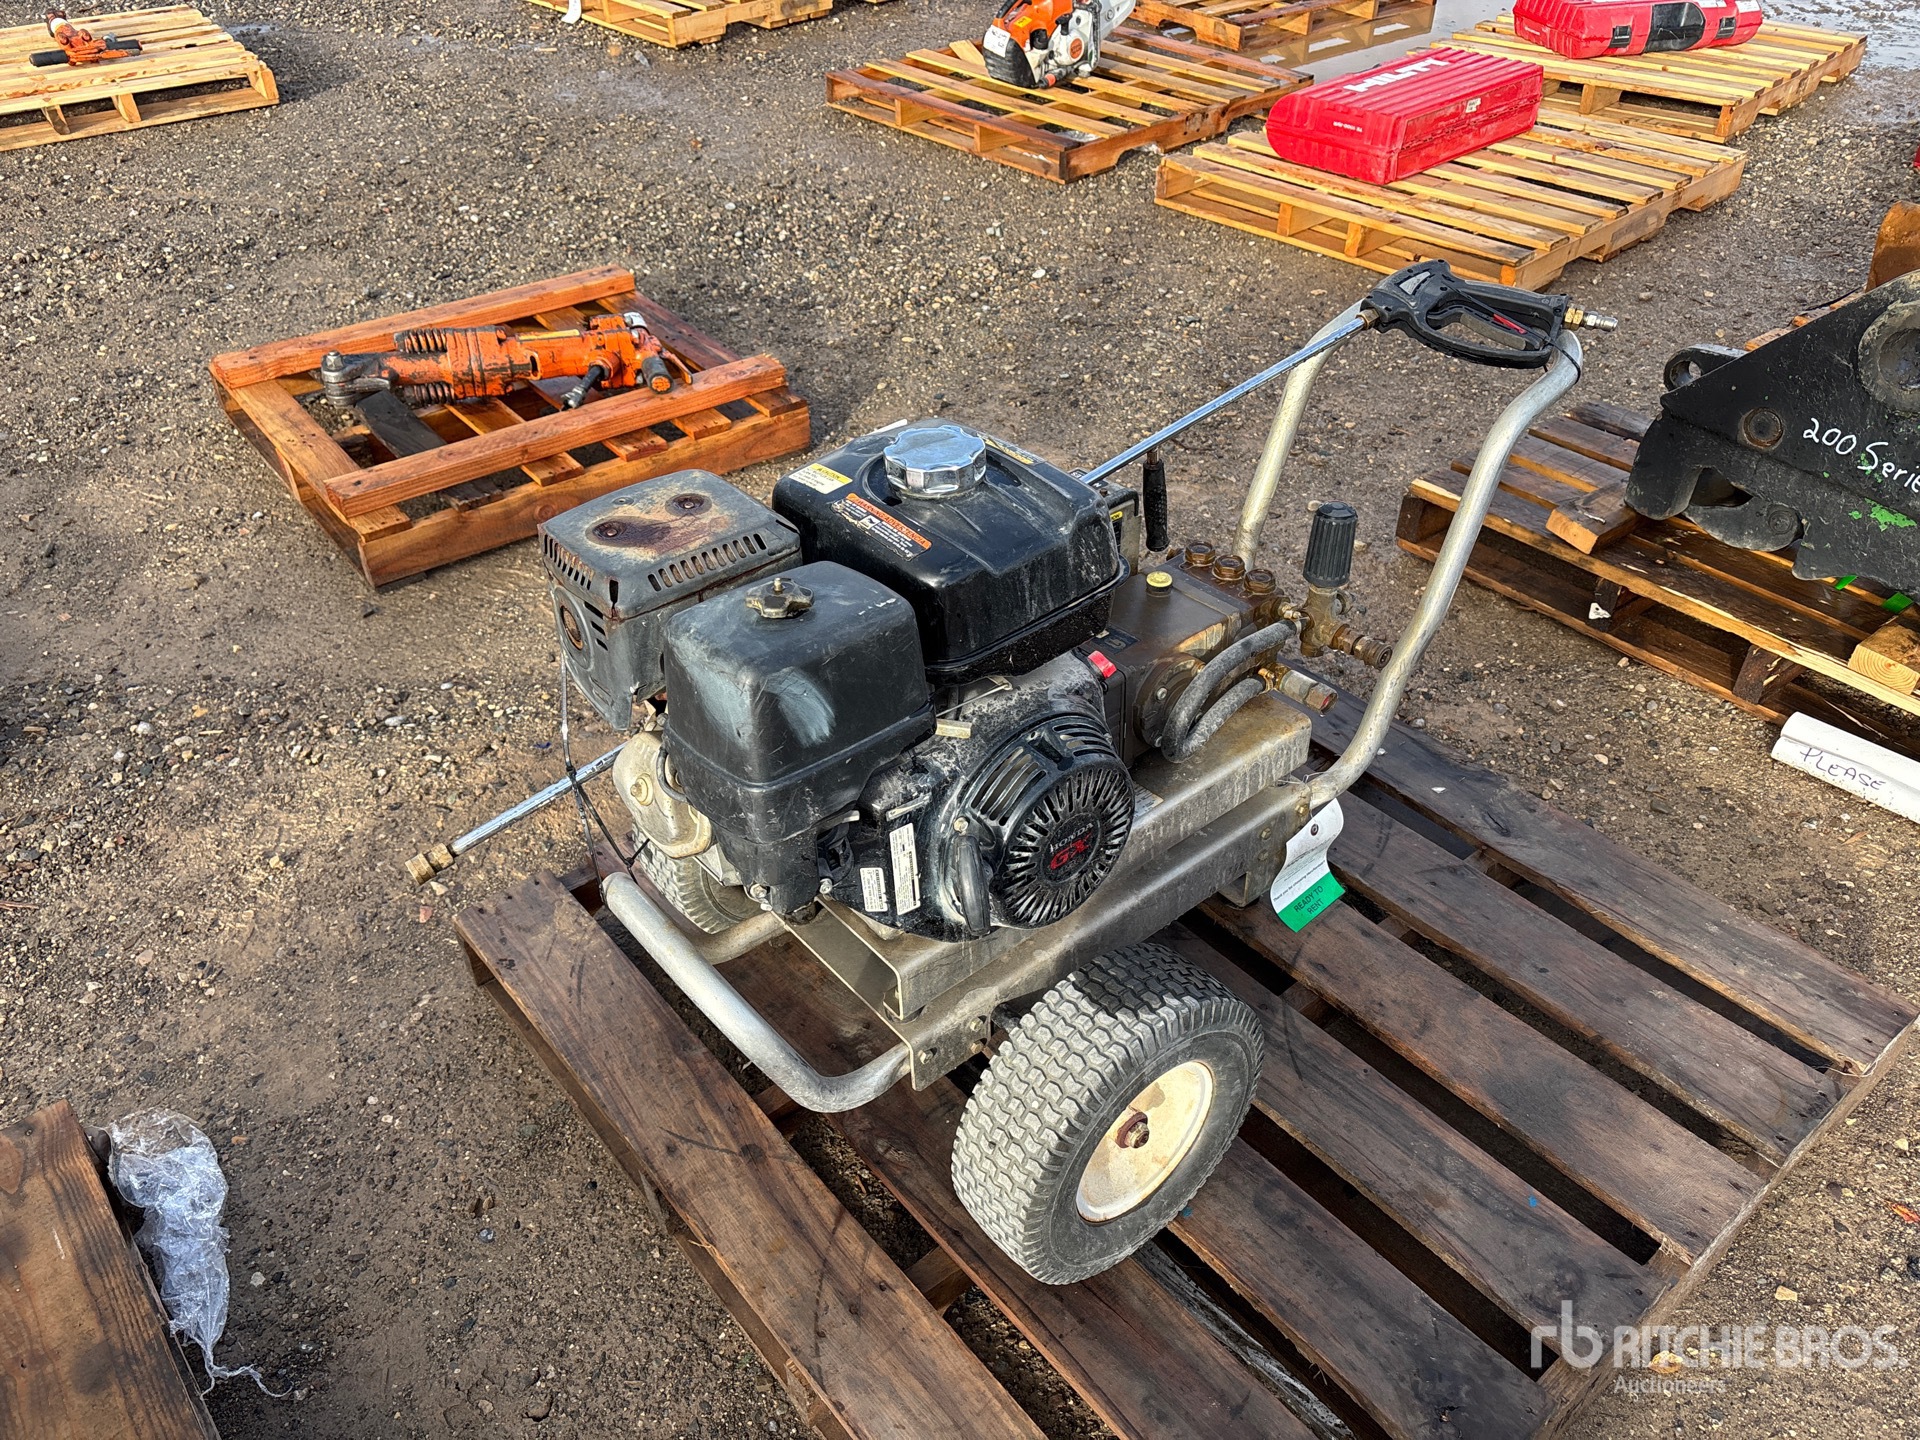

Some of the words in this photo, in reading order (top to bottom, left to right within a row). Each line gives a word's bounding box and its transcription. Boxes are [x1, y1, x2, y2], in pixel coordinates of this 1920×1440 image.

[1343, 57, 1450, 93] HILTI
[1803, 417, 1857, 455] 200
[1799, 747, 1886, 790] PLEASE
[1049, 822, 1094, 854] HONDA
[1050, 832, 1092, 870] GX
[1293, 891, 1315, 912] READY
[1313, 885, 1324, 896] TO
[1306, 898, 1324, 915] RENT
